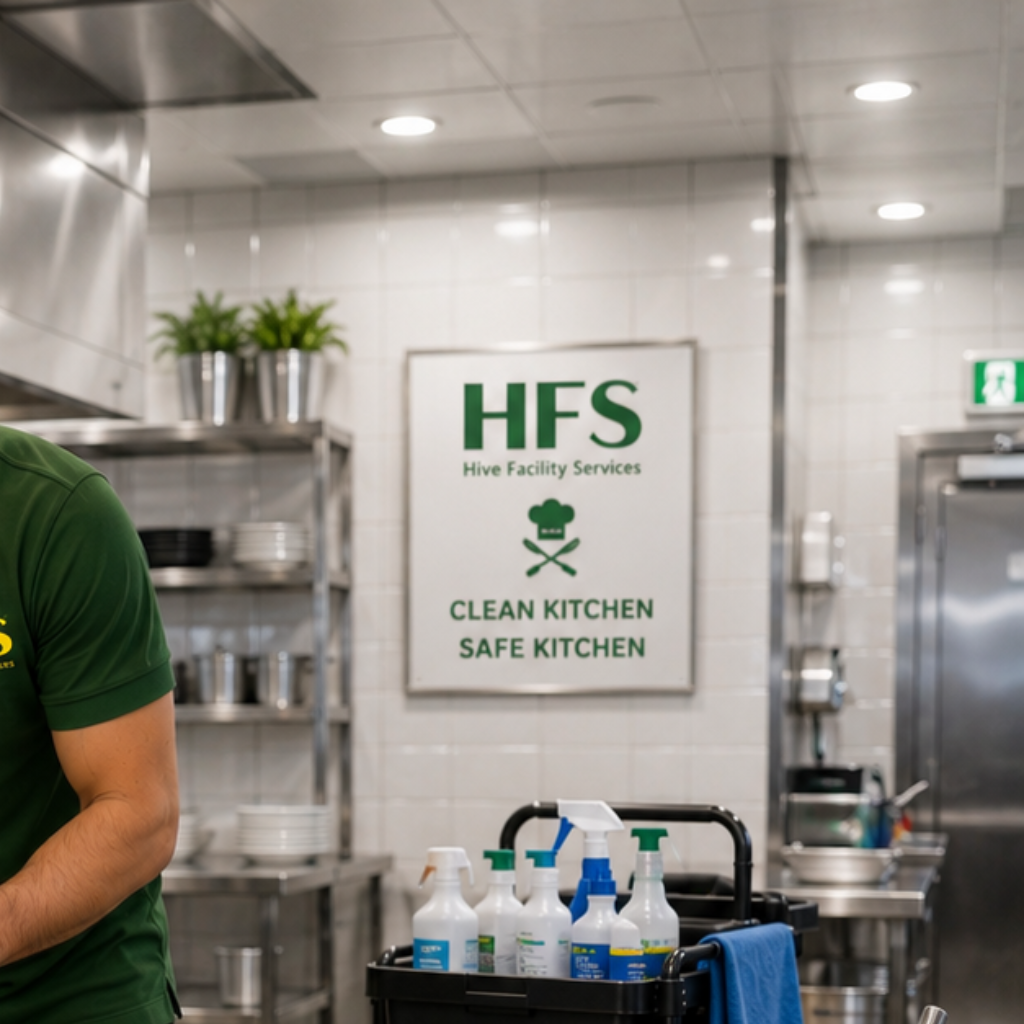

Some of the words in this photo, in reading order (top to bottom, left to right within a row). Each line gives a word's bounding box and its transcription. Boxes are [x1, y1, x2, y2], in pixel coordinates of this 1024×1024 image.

[463, 379, 643, 451] HFS
[463, 461, 502, 477] Hive
[507, 460, 567, 479] Facility
[573, 459, 641, 476] Services
[449, 599, 534, 621] CLEAN
[543, 598, 654, 620] KITCHEN
[459, 637, 525, 659] SAFE
[533, 636, 645, 659] KITCHEN
